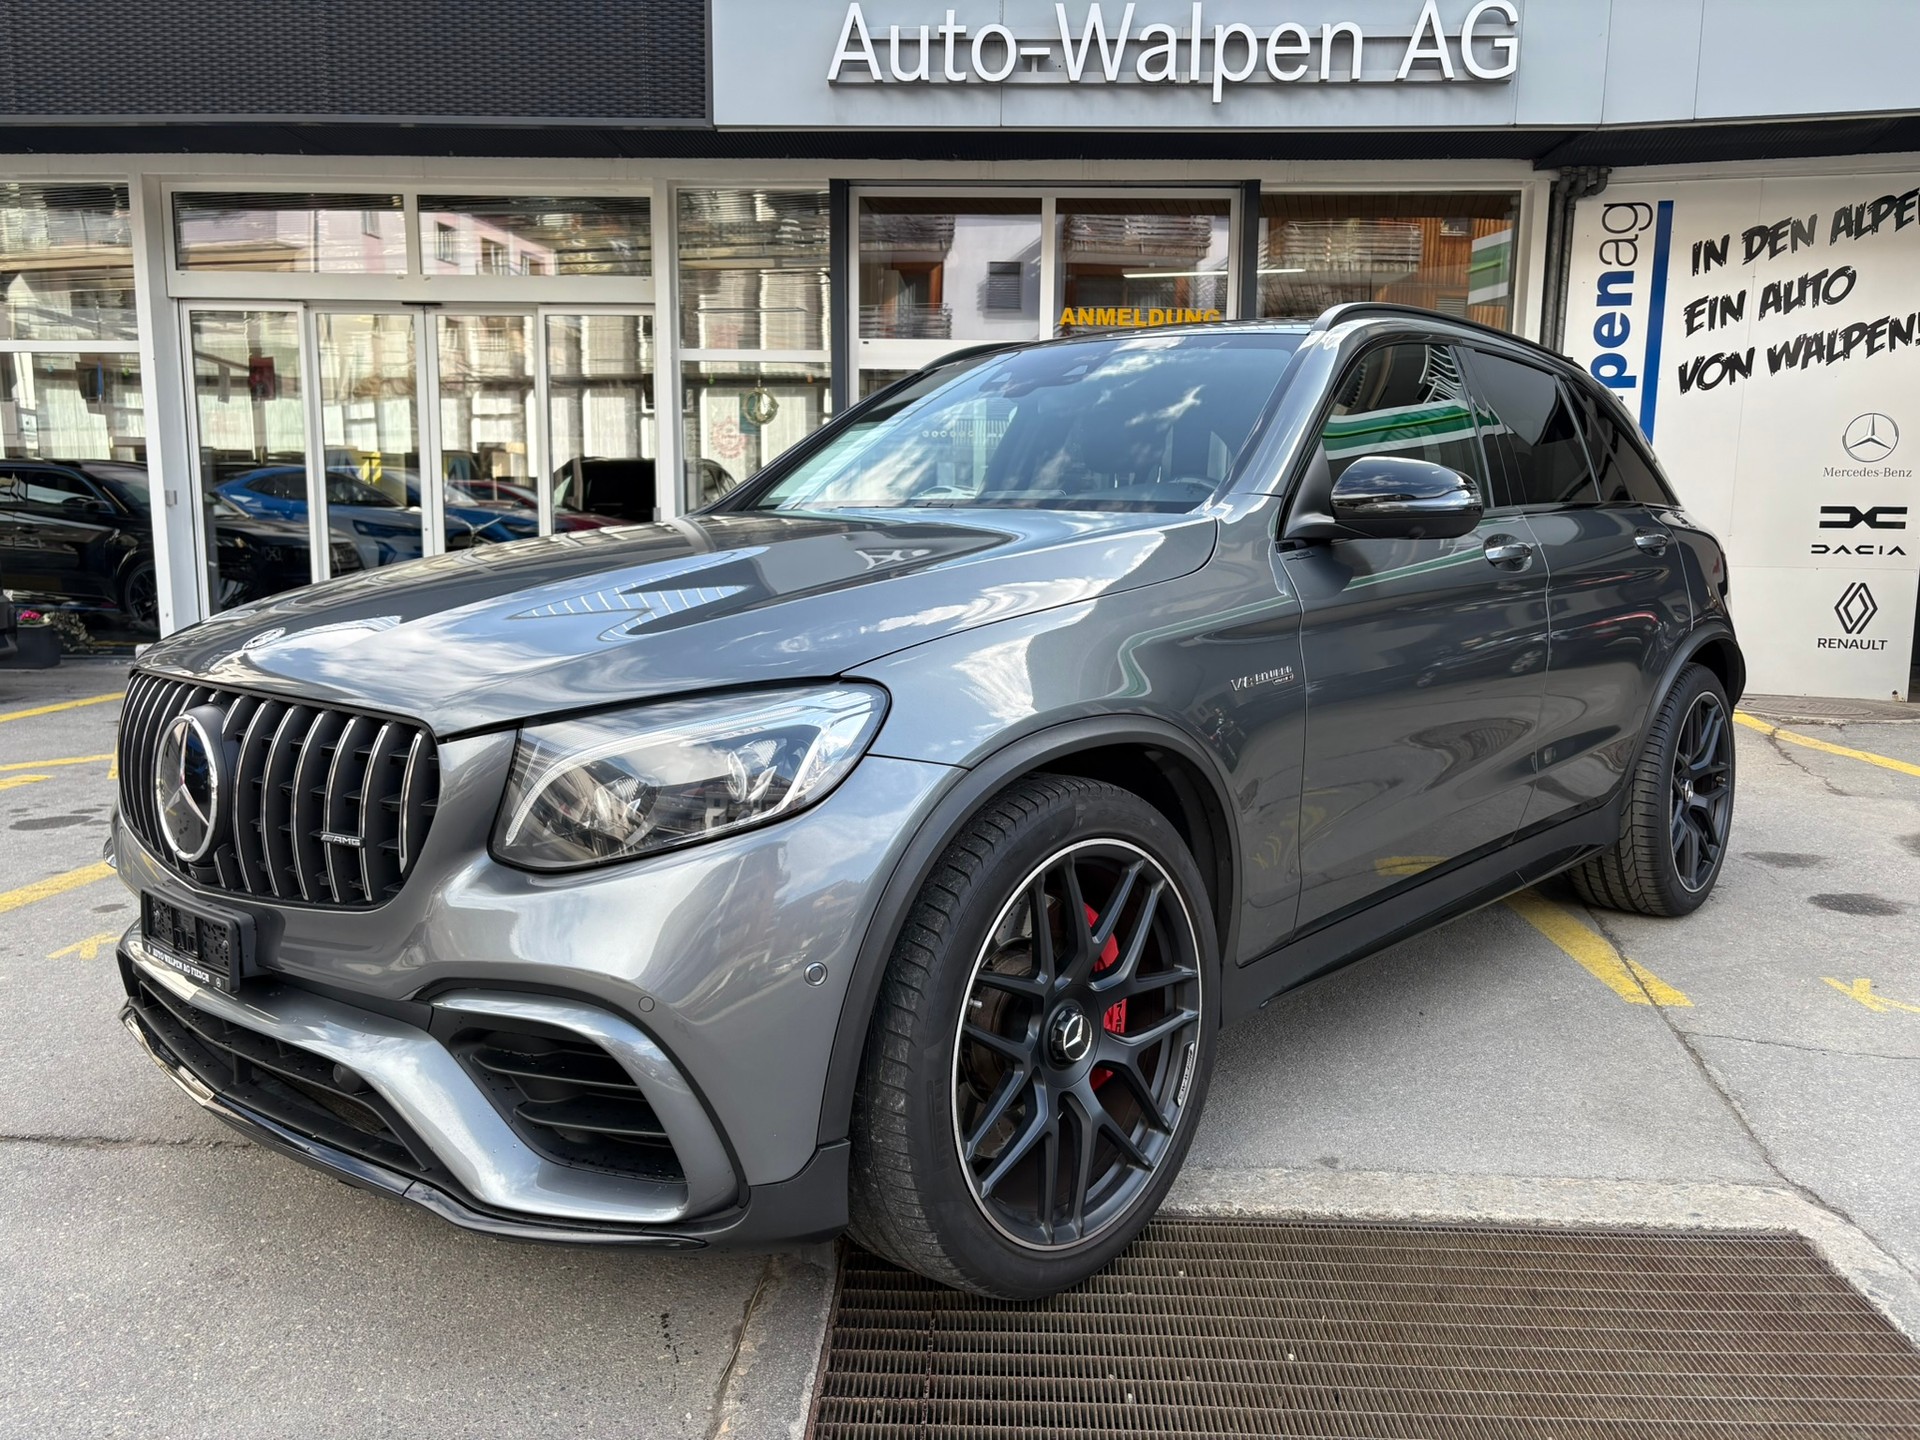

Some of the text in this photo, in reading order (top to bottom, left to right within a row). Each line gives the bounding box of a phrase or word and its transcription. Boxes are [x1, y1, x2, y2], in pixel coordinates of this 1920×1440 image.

[828, 0, 1520, 103] Auto-Walpen AG
[1691, 187, 1920, 277] IN DEN ALPE
[1683, 265, 1857, 338] EIN AUTO
[1059, 307, 1221, 327] ANMELDUNG
[1678, 346, 1755, 395] VON
[1823, 466, 1913, 478] Mercedes-Benz
[1811, 544, 1907, 556] DACIA
[1817, 637, 1888, 651] RENAULT
[332, 835, 361, 847] AMG
